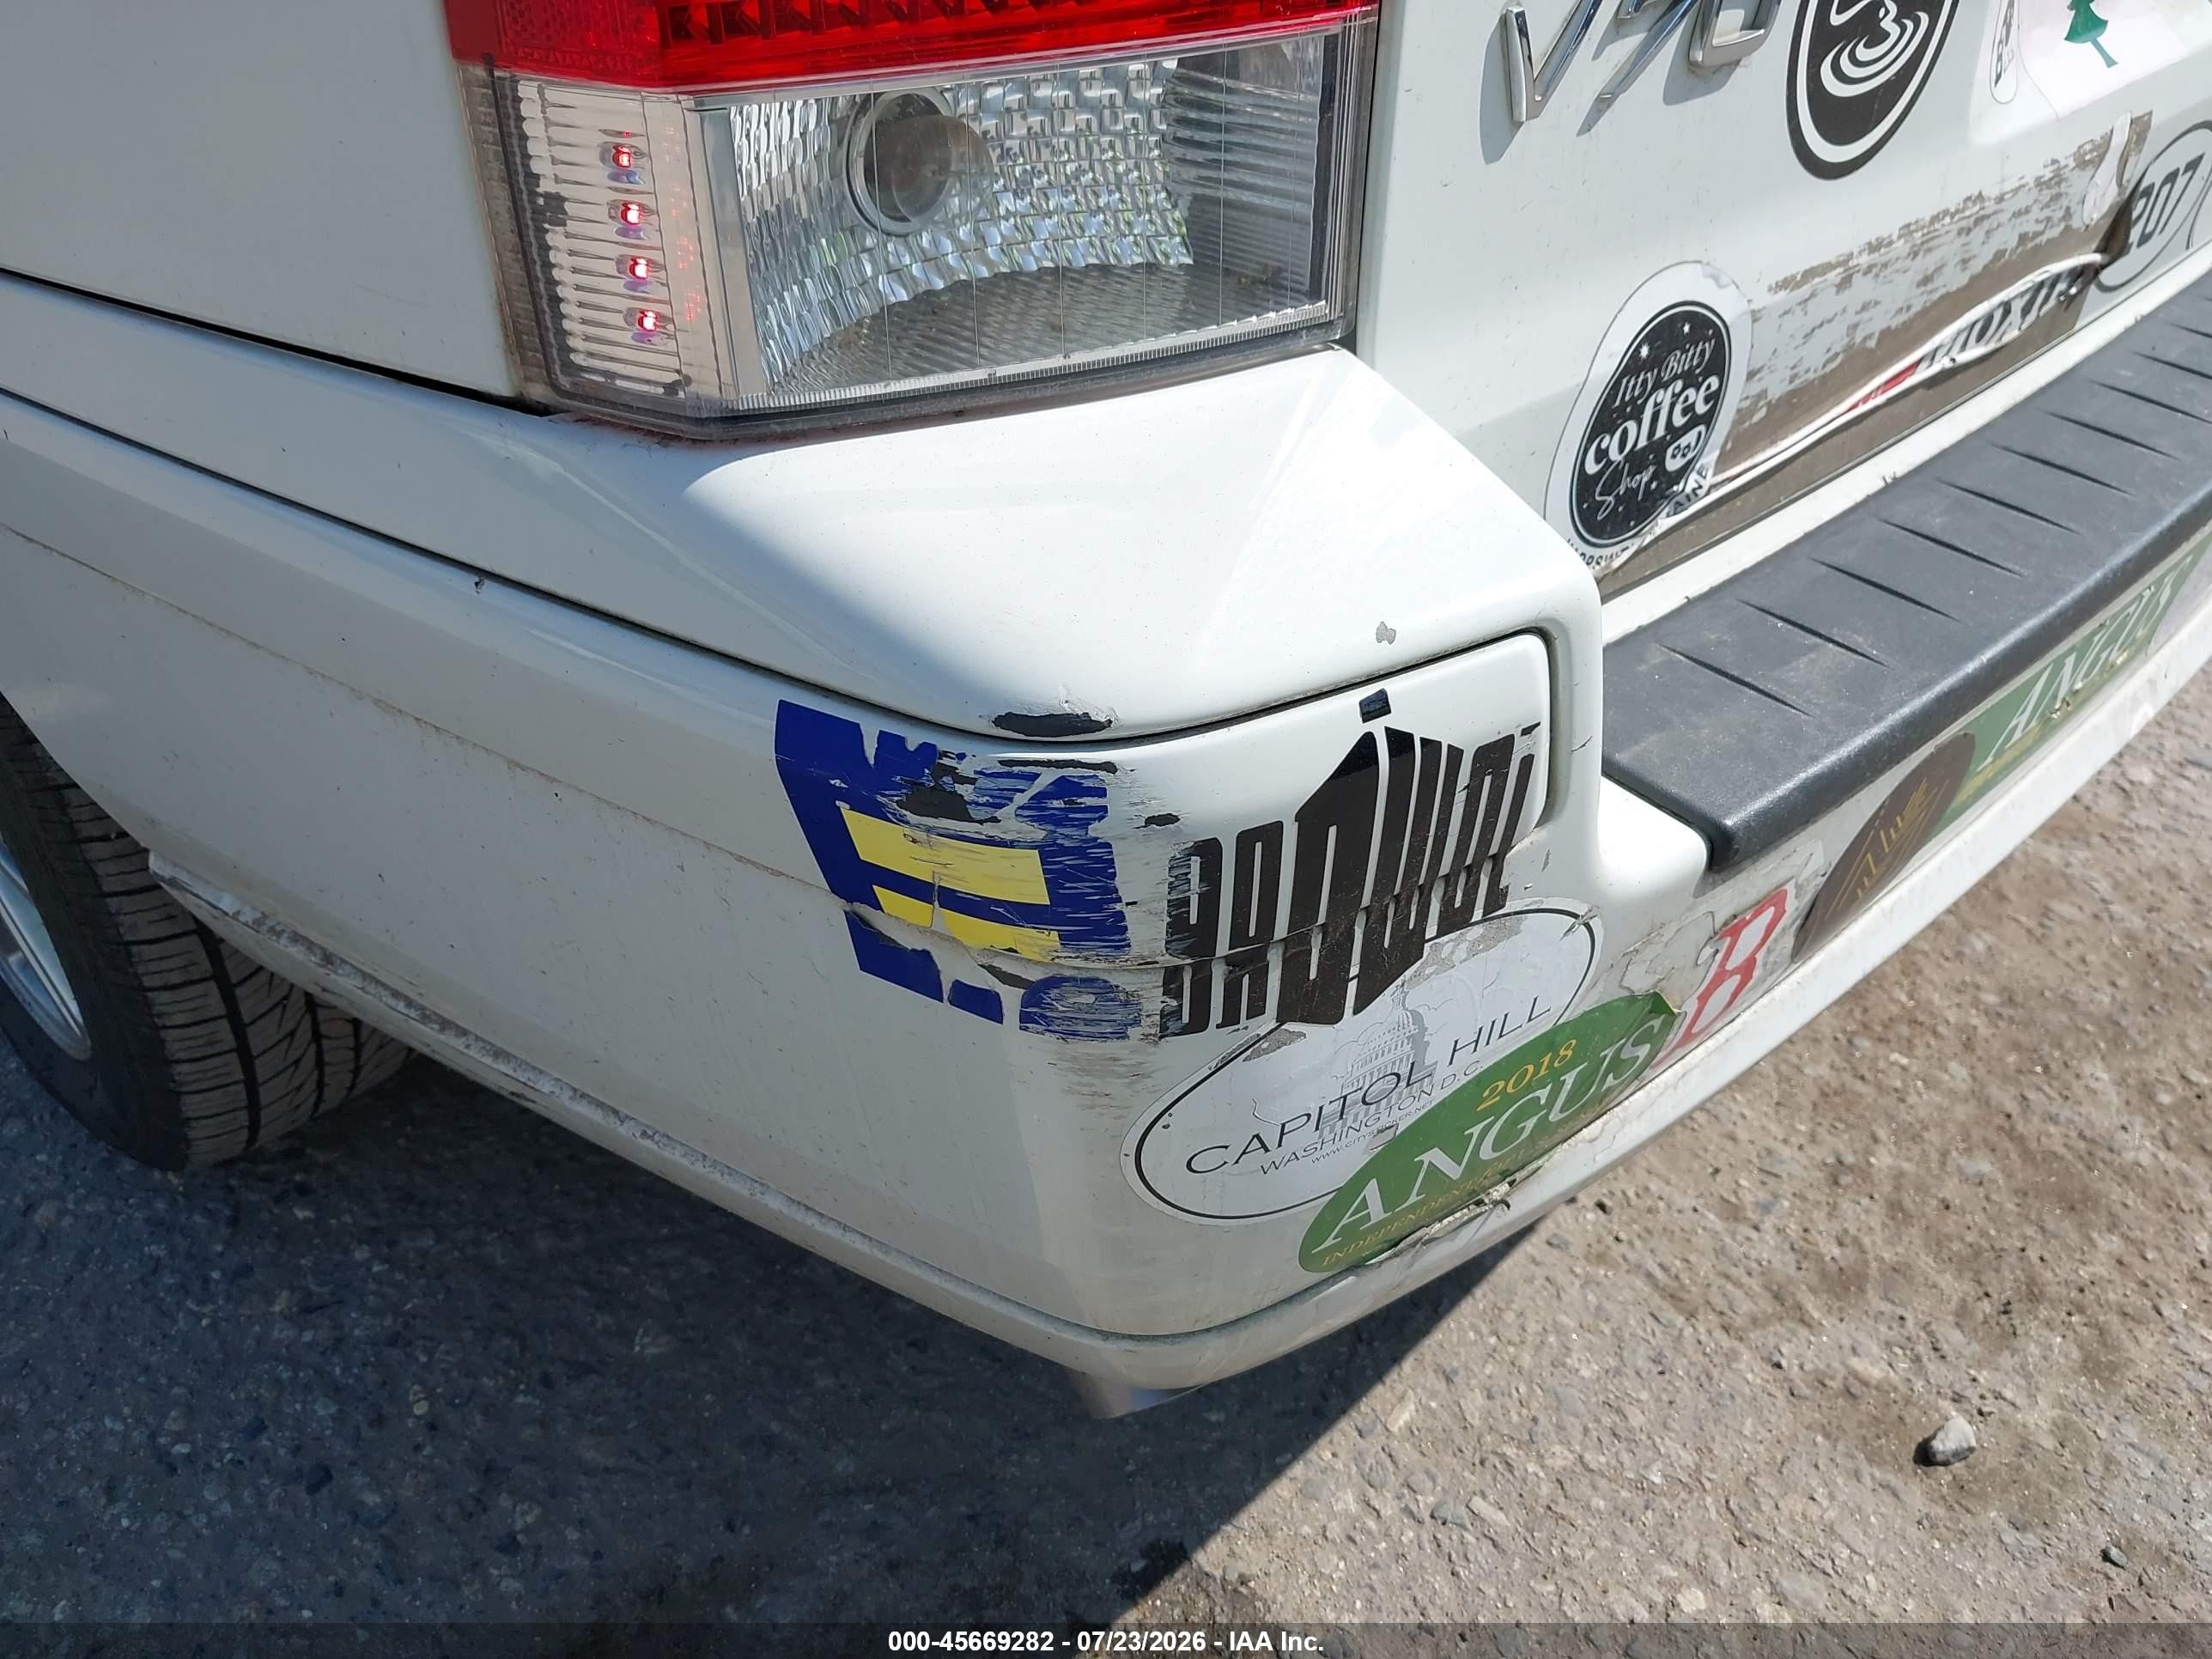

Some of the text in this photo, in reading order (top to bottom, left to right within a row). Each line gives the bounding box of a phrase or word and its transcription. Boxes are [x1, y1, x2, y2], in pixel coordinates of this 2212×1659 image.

[1612, 337, 1716, 409] Itty Bitty
[1584, 375, 1719, 475] coffee
[1595, 459, 1656, 520] Shop
[1186, 1060, 1432, 1174] CAPITOL
[1449, 996, 1552, 1066] HILL
[1260, 1083, 1435, 1176] WASHINGTON
[1441, 1060, 1484, 1090] D.C.
[1475, 1038, 1577, 1111] 2018
[1311, 1014, 1664, 1254] ANGUS
